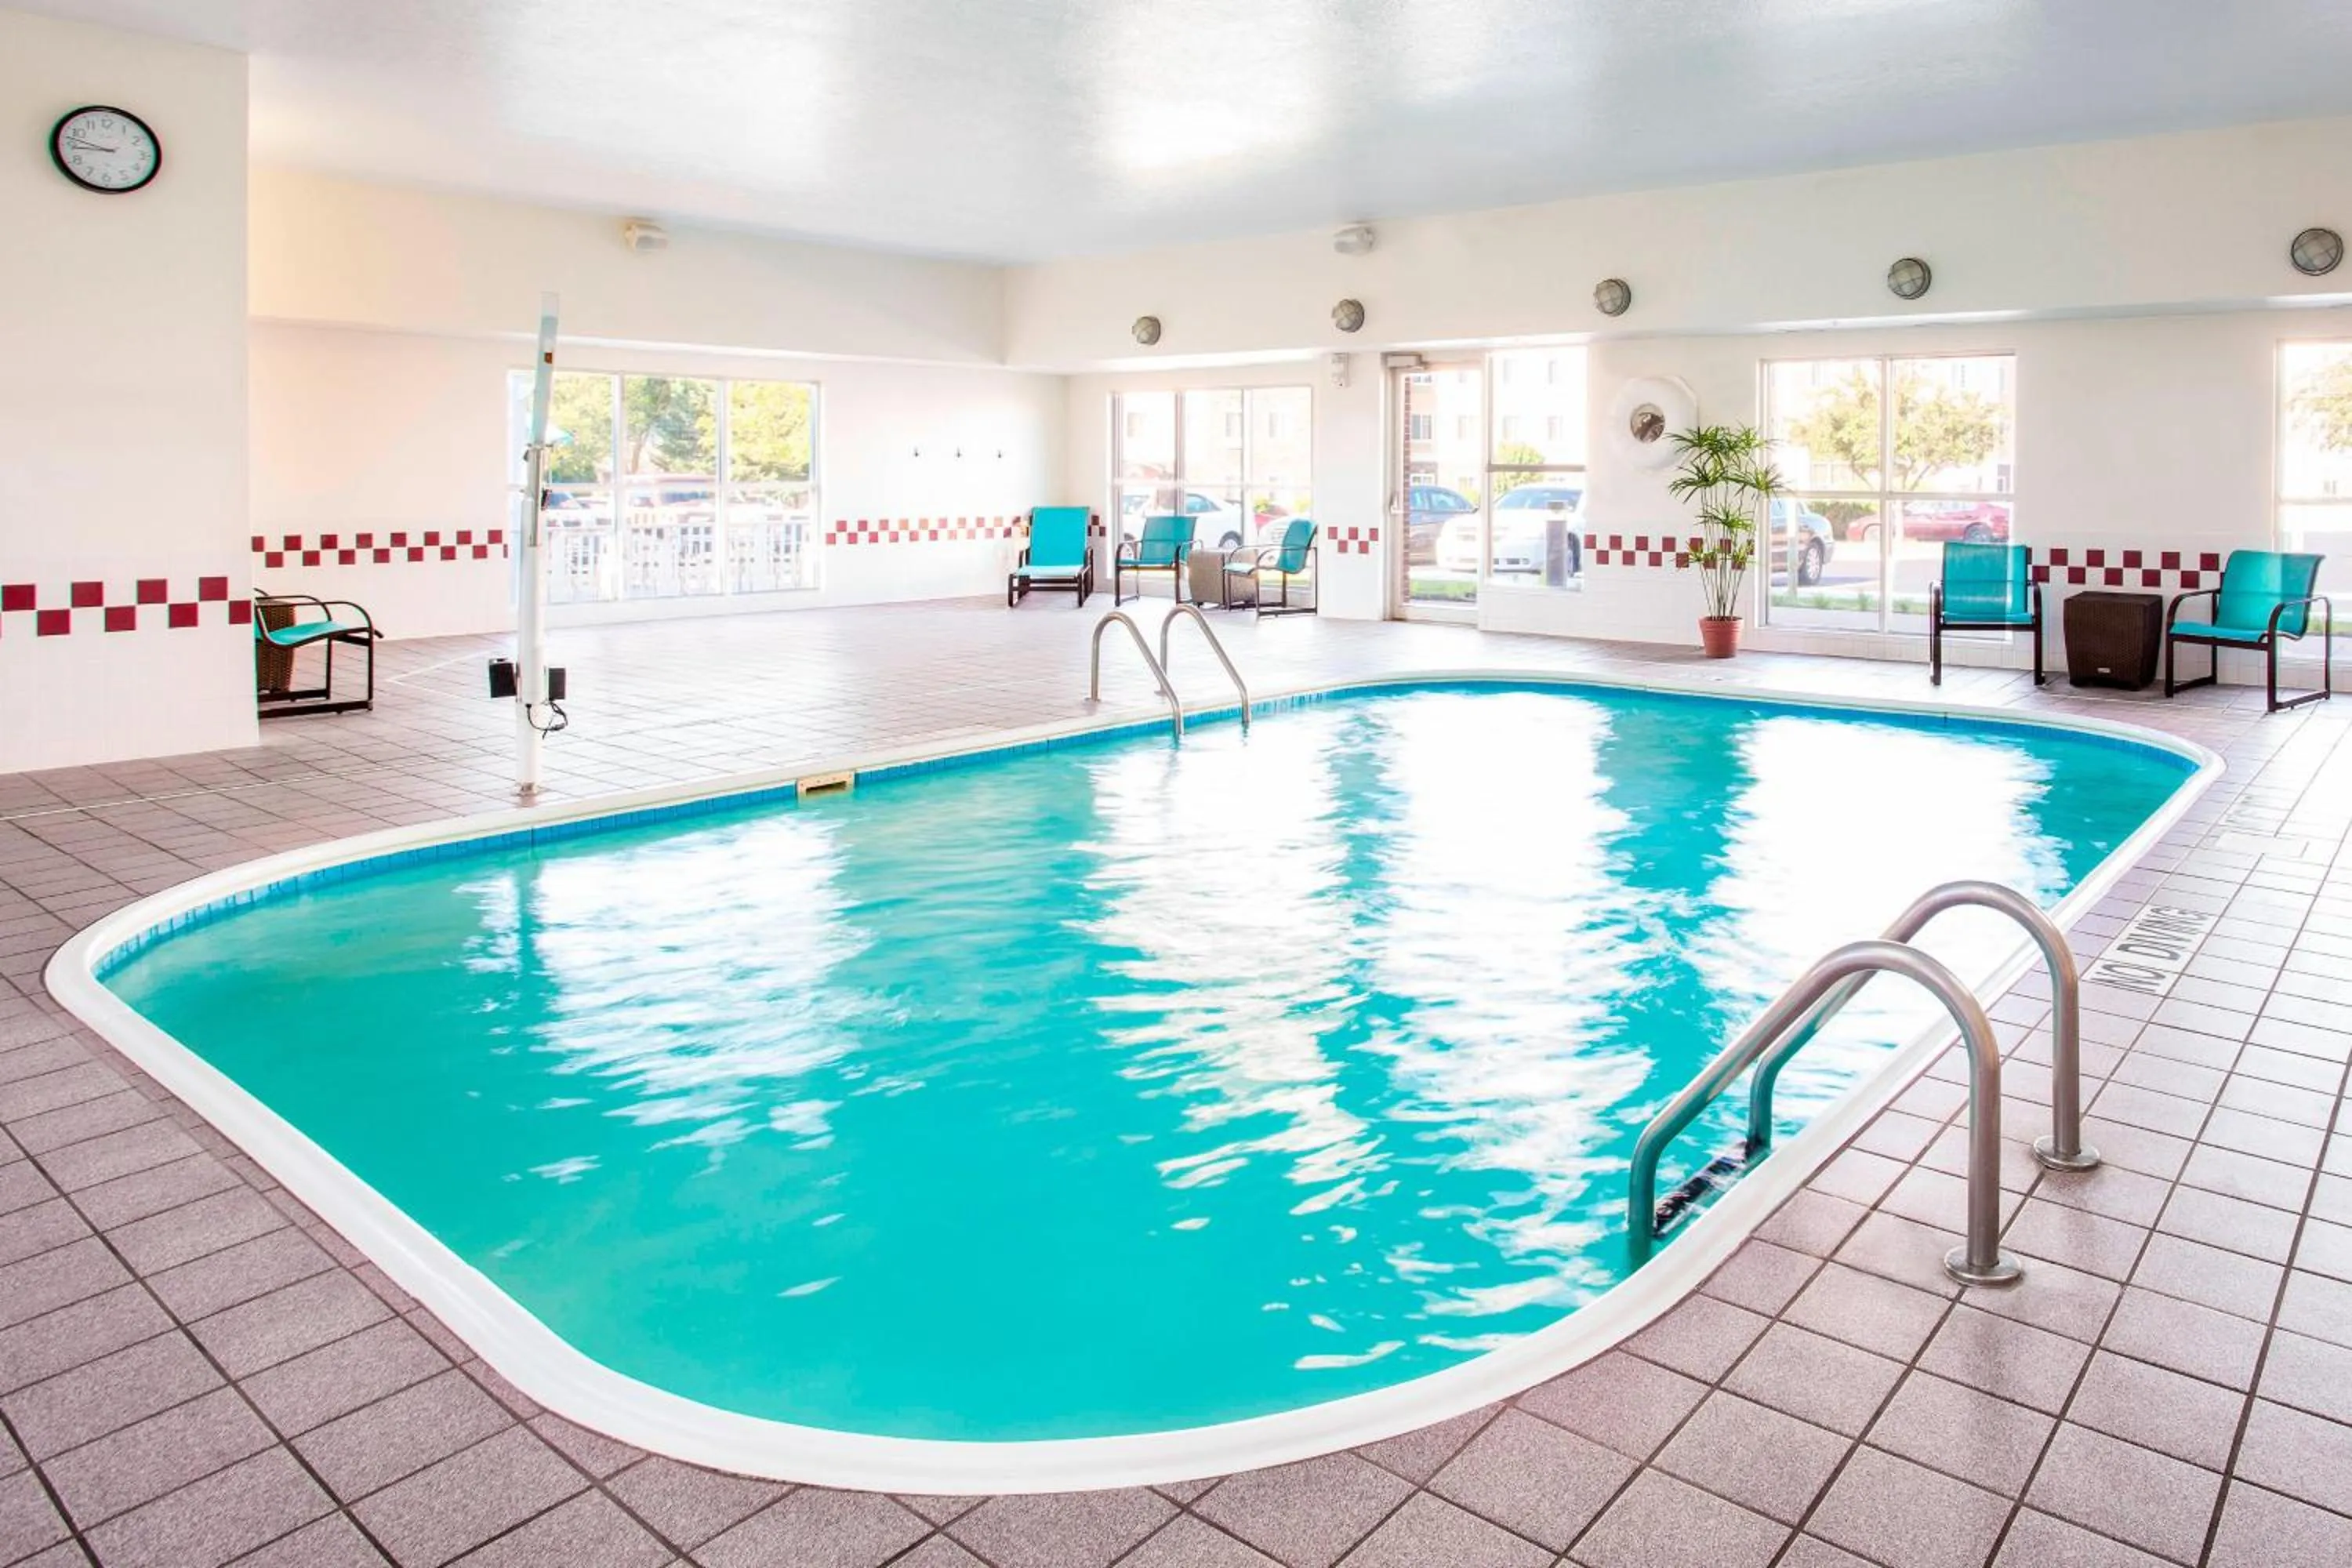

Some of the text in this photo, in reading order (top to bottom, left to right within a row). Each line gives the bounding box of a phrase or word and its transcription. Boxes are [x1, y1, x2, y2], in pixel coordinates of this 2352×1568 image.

[86, 119, 96, 131] 11
[72, 128, 86, 139] 10
[132, 135, 141, 146] 2
[73, 154, 82, 165] 8
[85, 166, 95, 176] 7
[119, 169, 129, 180] 5
[102, 172, 111, 183] 6
[2089, 906, 2209, 993] NO DIVING
